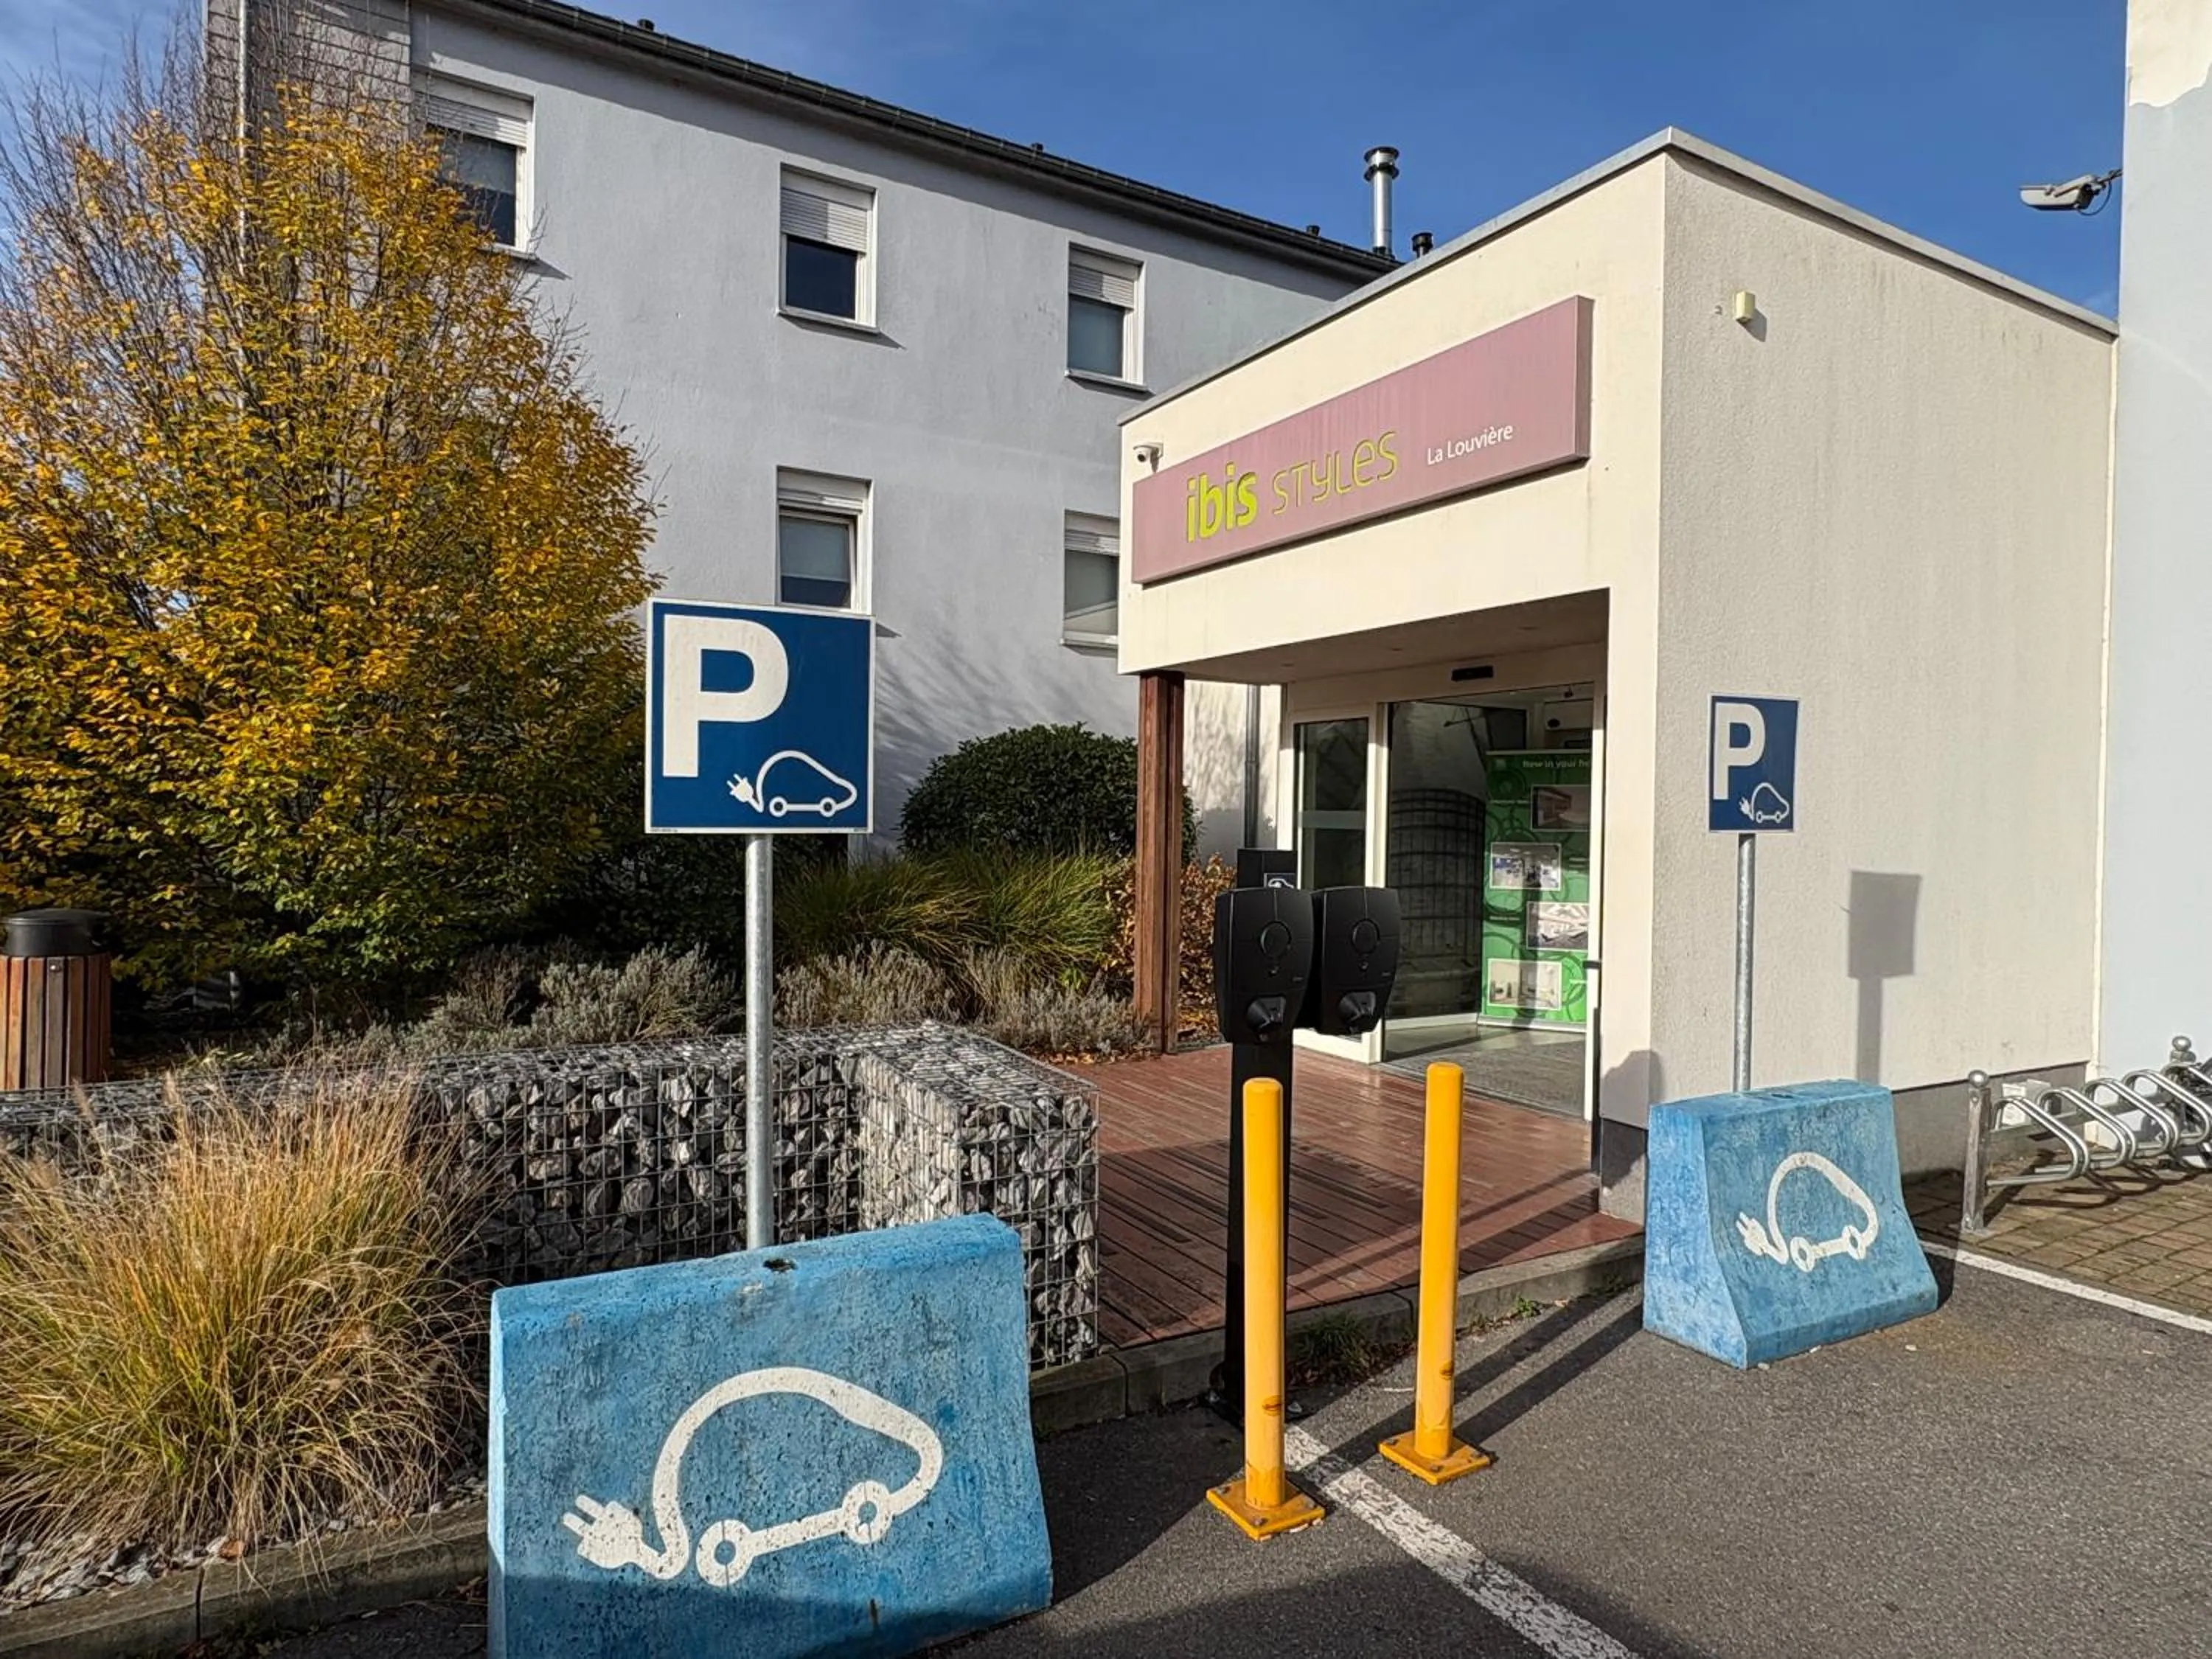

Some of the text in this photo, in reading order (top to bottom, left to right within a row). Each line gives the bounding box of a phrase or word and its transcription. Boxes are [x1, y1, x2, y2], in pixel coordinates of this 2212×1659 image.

[1427, 425, 1514, 465] La Louvière
[1186, 462, 1259, 543] ibis
[664, 613, 788, 778] P
[1713, 702, 1766, 800] P
